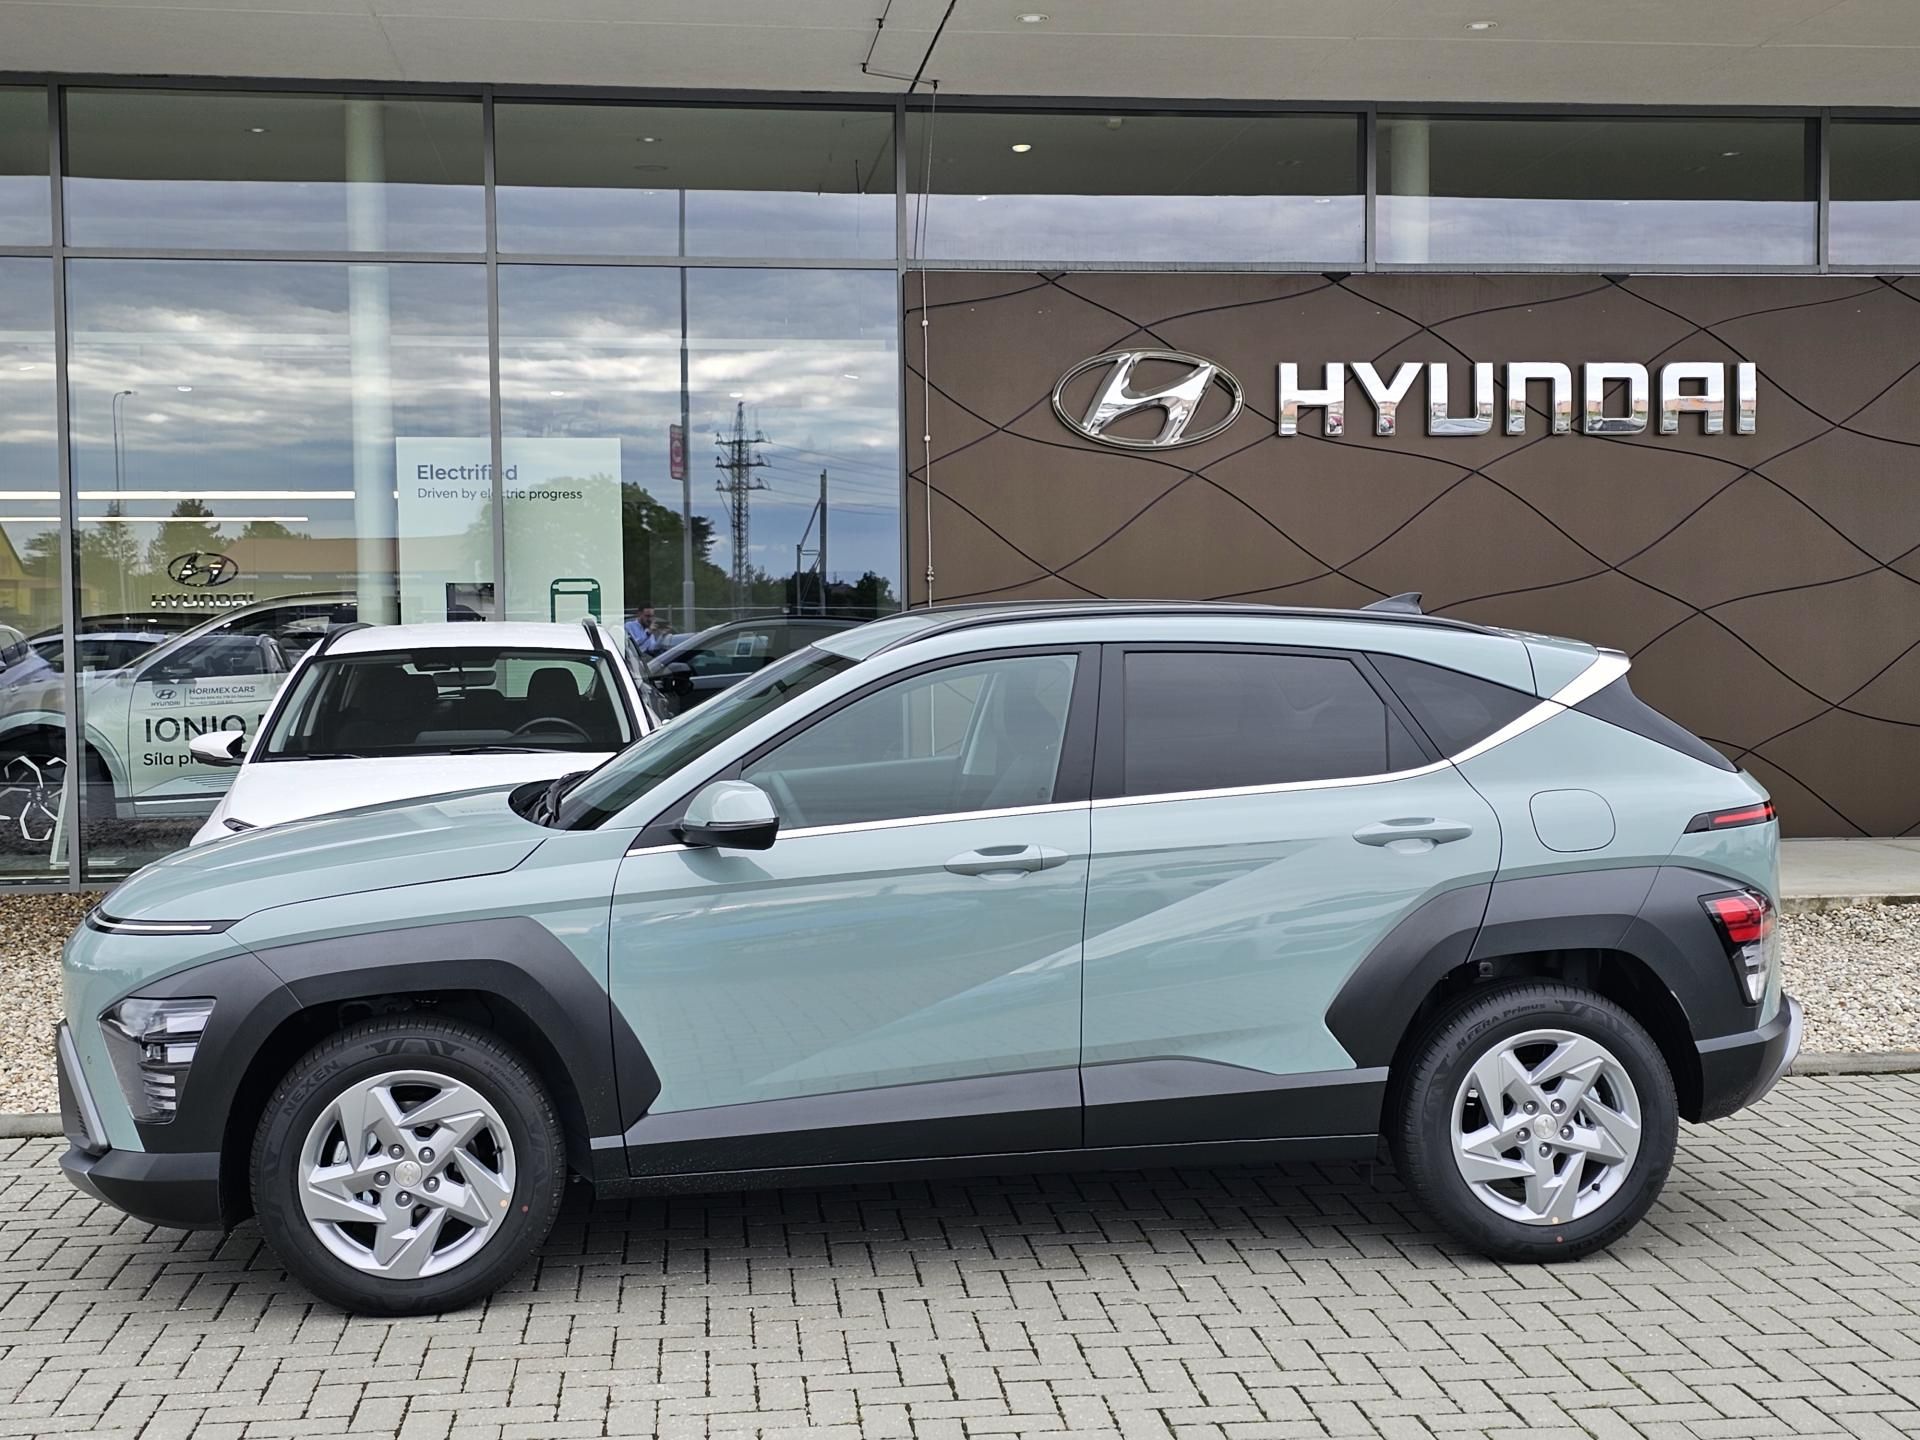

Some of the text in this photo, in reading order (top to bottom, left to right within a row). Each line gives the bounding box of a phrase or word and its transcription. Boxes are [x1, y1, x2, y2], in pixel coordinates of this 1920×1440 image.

[1277, 361, 1757, 437] HYUNDAI
[417, 464, 518, 481] Electrifid
[417, 487, 583, 501] Driven by eltric progress
[188, 687, 230, 695] HORIMEX
[143, 752, 174, 766] Síla
[1503, 1003, 1546, 1017] Primus
[283, 1060, 340, 1117] NEXEN
